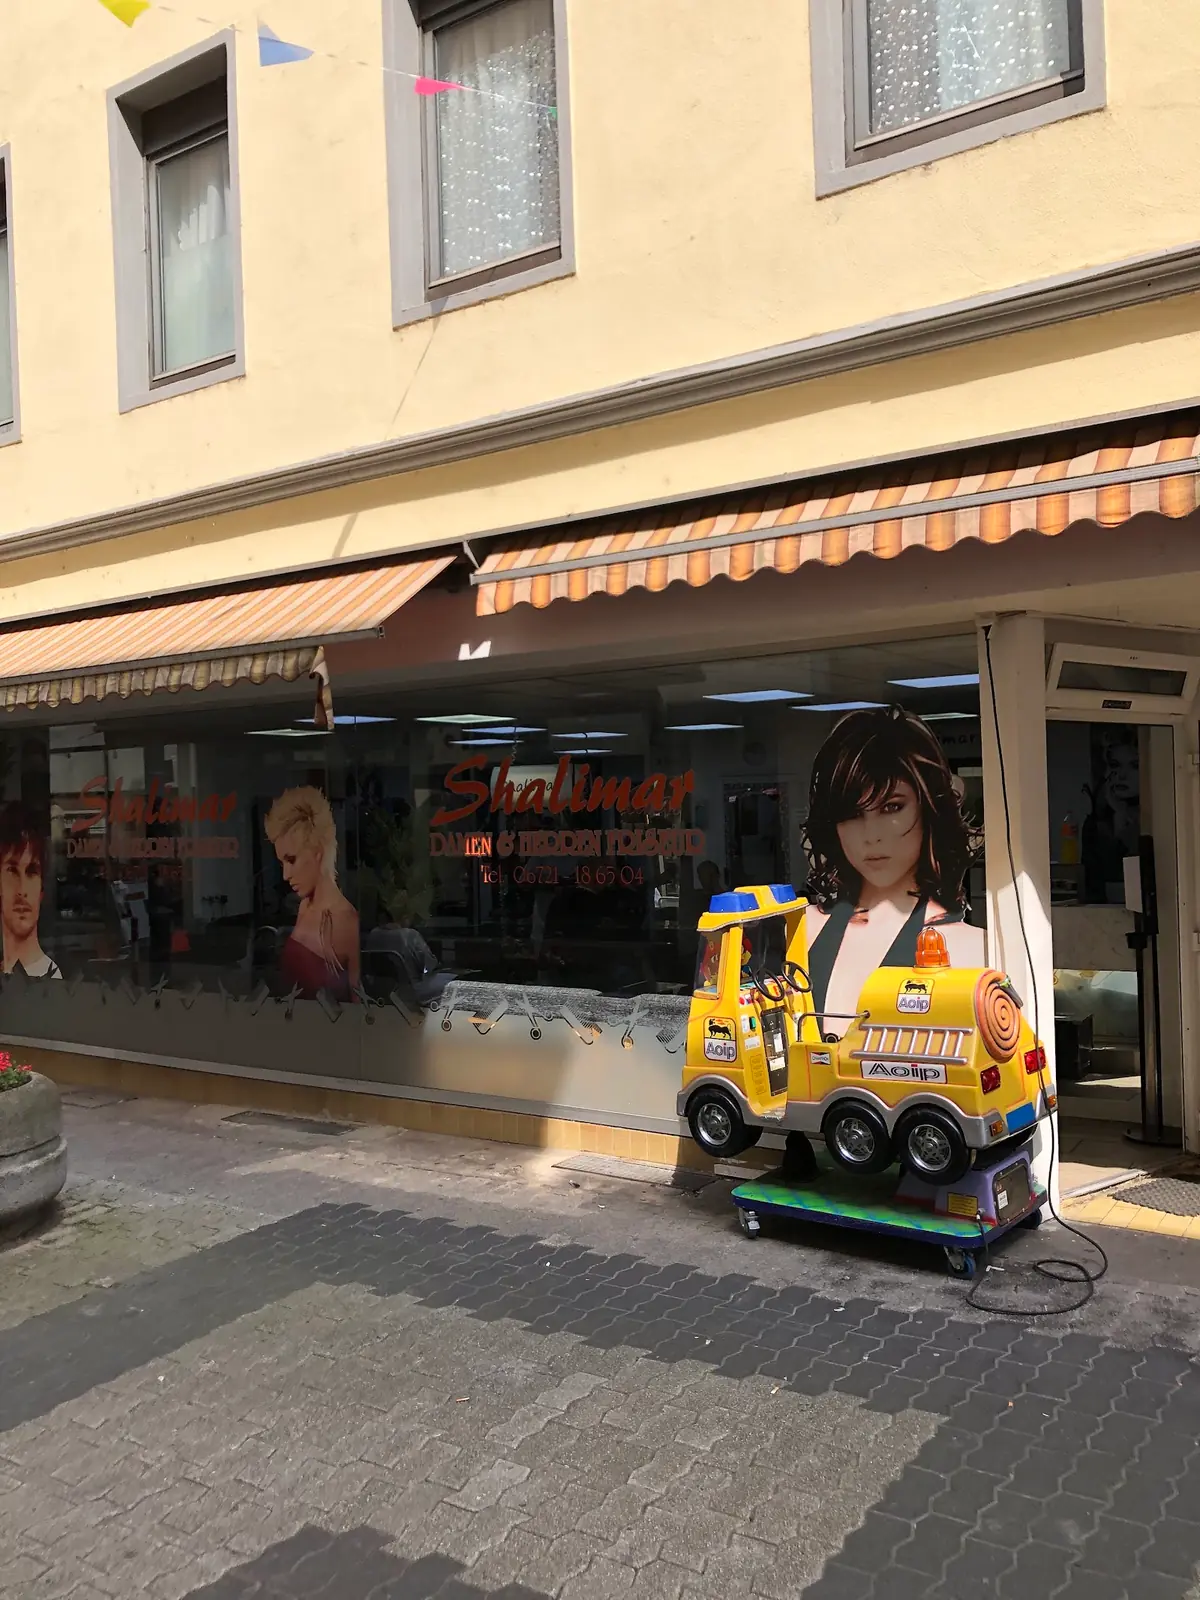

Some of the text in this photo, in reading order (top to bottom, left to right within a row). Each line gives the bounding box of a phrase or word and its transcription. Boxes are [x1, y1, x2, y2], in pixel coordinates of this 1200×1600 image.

[429, 754, 695, 826] Shalimar
[71, 775, 237, 833] Shalimar
[512, 865, 560, 884] 06721
[575, 865, 591, 884] 18
[596, 865, 616, 884] 65
[620, 865, 644, 884] 04
[898, 996, 928, 1011] Aoip
[705, 1041, 735, 1060] Aoip
[868, 1063, 940, 1081] Aoip
